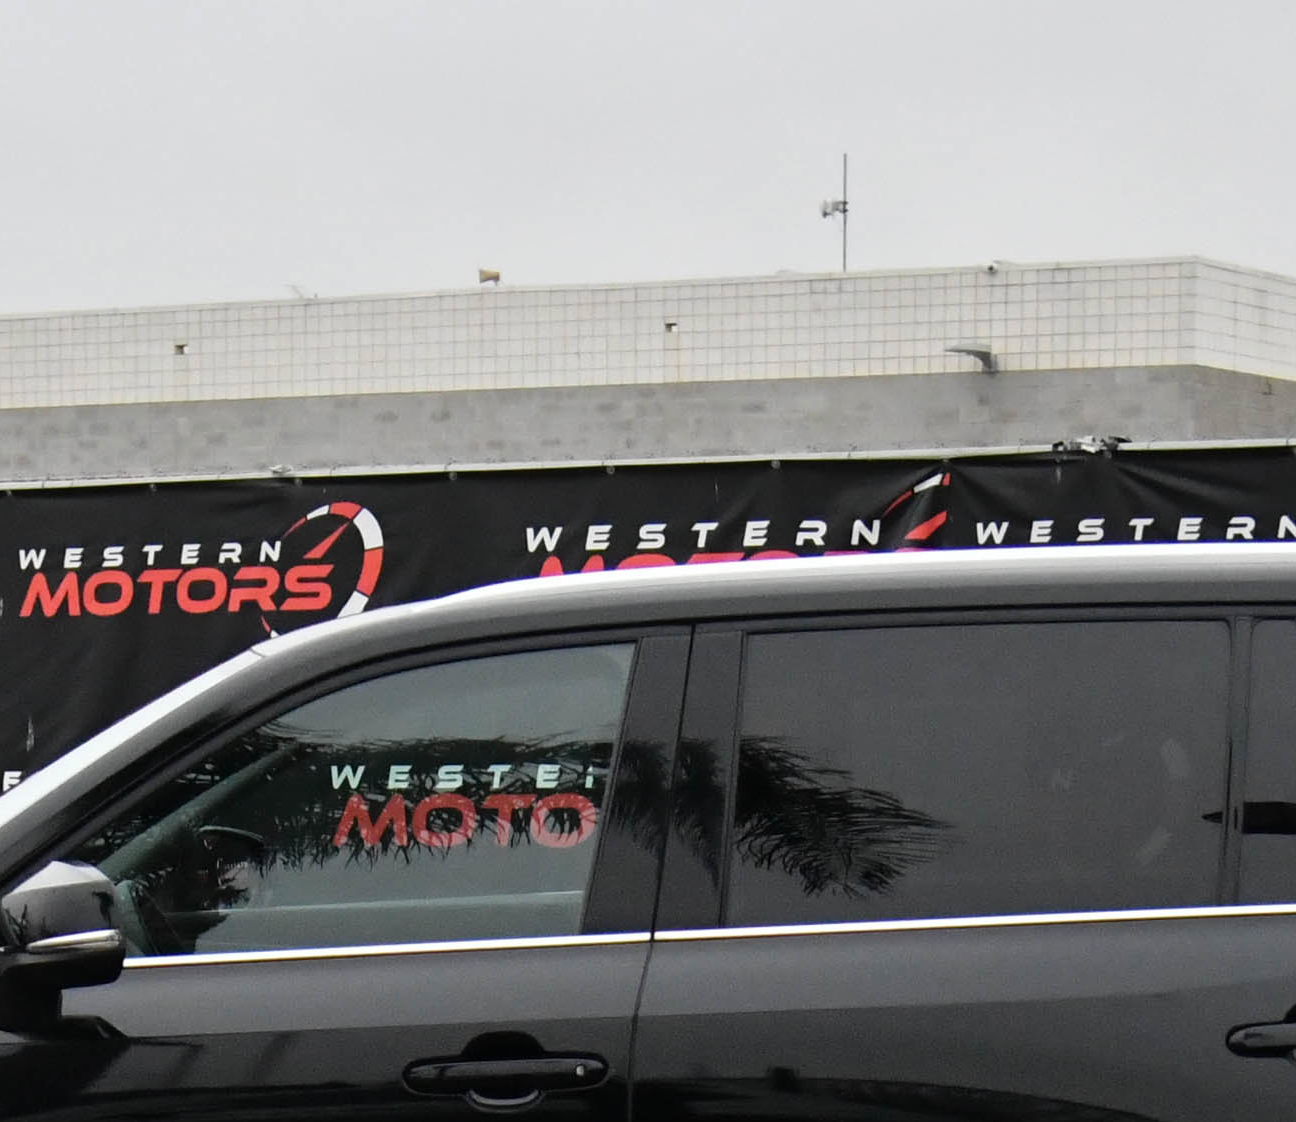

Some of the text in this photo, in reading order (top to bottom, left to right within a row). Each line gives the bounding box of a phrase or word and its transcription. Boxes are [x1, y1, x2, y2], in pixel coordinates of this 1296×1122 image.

[526, 520, 880, 552] WESTERN
[19, 541, 281, 569] WESTERN
[20, 564, 334, 618] MOTORS
